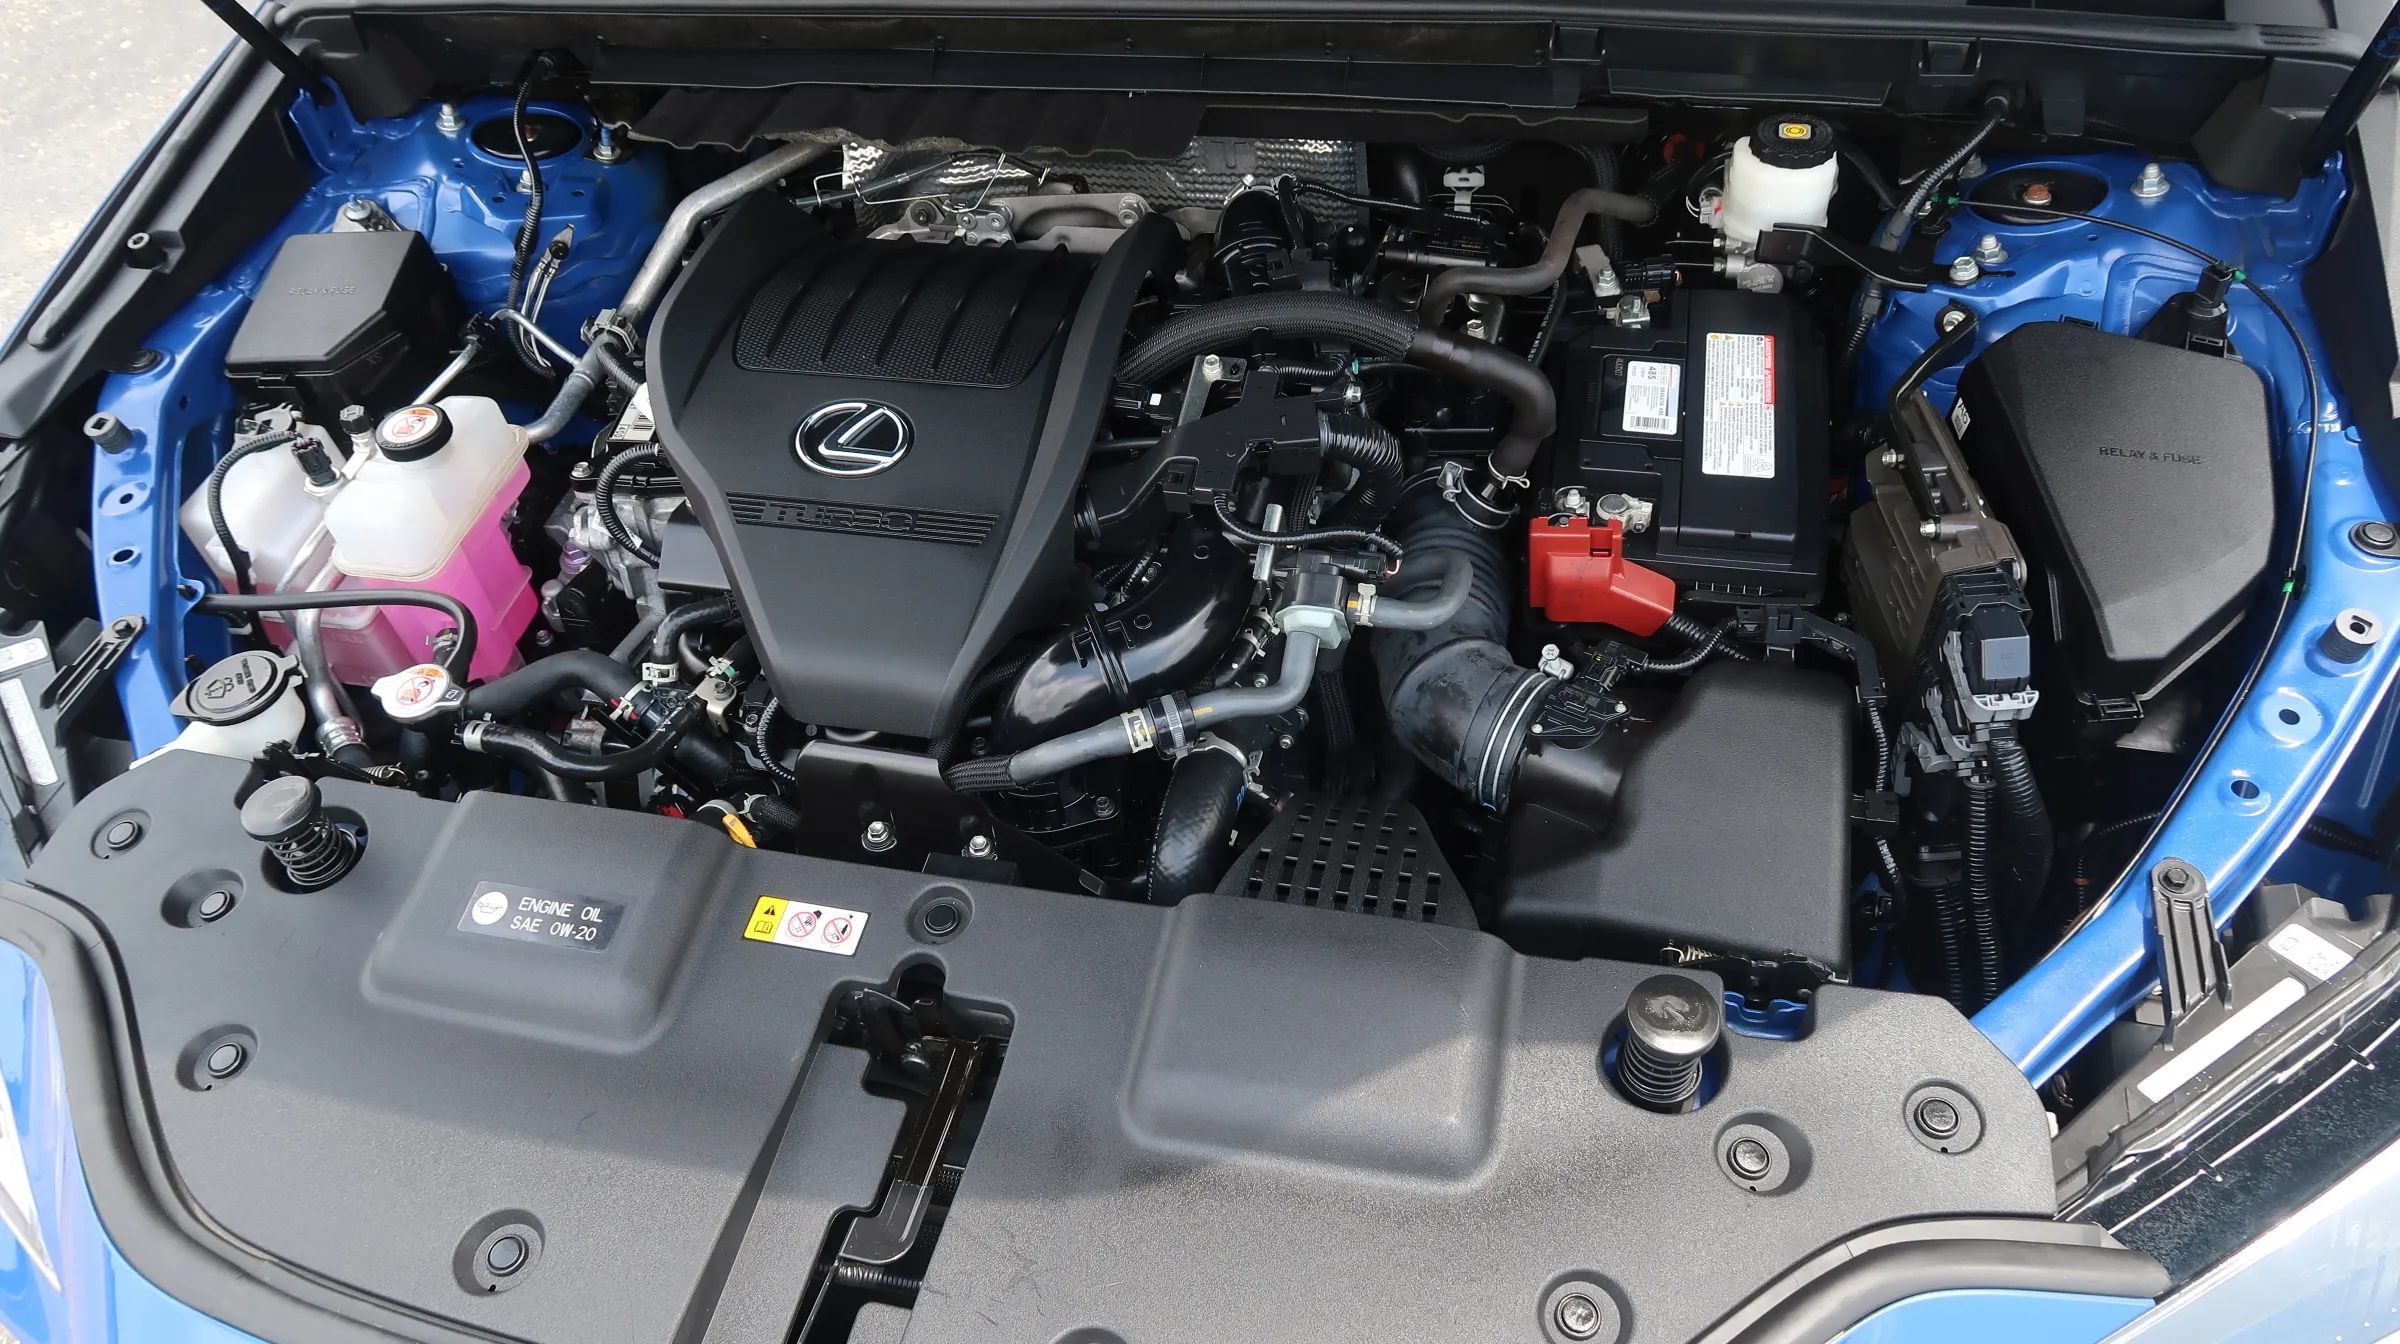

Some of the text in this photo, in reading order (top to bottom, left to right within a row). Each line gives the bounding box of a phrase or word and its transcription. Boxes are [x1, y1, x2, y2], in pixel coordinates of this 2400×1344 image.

[2099, 446, 2202, 465] RELAY & FUSE
[761, 499, 912, 531] TURBO
[518, 896, 603, 923] ENGINE OIL
[510, 915, 597, 941] SAE 0W-20
